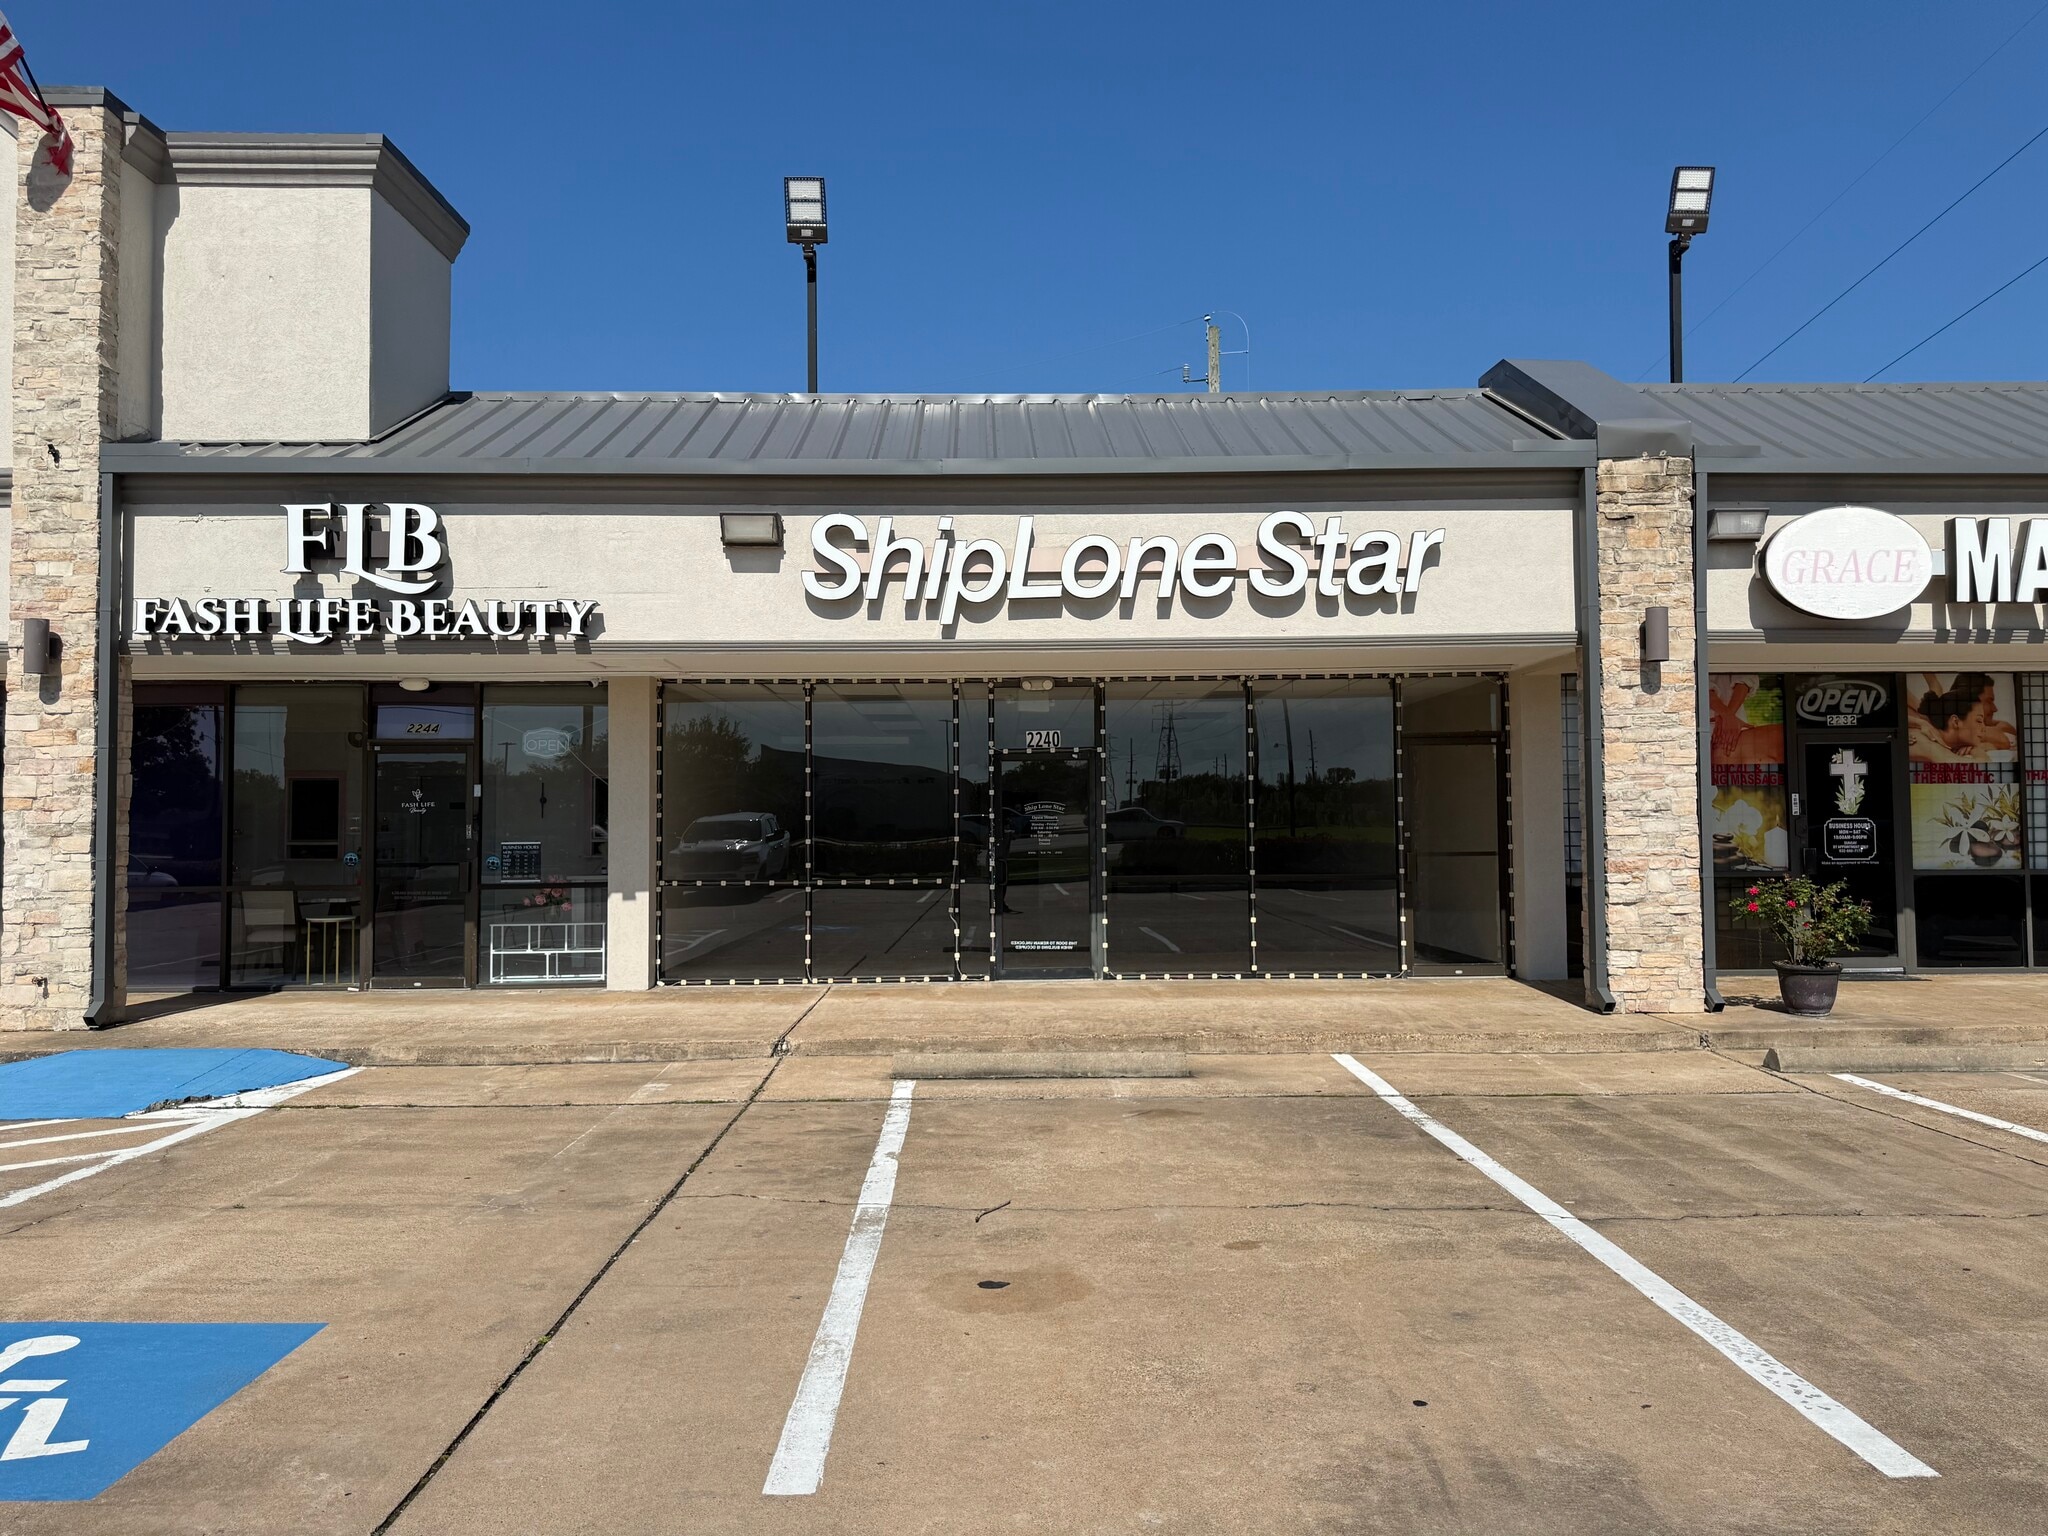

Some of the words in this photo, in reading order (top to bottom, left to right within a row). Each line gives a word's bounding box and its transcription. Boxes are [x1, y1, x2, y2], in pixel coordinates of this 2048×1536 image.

[280, 502, 443, 595] FLB
[1247, 510, 1446, 597] Star
[1781, 549, 1919, 585] GRACE
[133, 598, 268, 636] FASH
[276, 598, 376, 645] LIFE
[386, 598, 599, 637] BEAUTY
[1802, 688, 1877, 714] OPEN
[1828, 716, 1856, 725] 2232
[406, 723, 441, 734] 2244
[525, 739, 568, 751] OPEN
[1027, 731, 1059, 748] 2240
[1923, 763, 1980, 772] PRENATAL
[1730, 774, 1784, 785] MASSAGE
[1914, 772, 1995, 784] THERAPEUTIC
